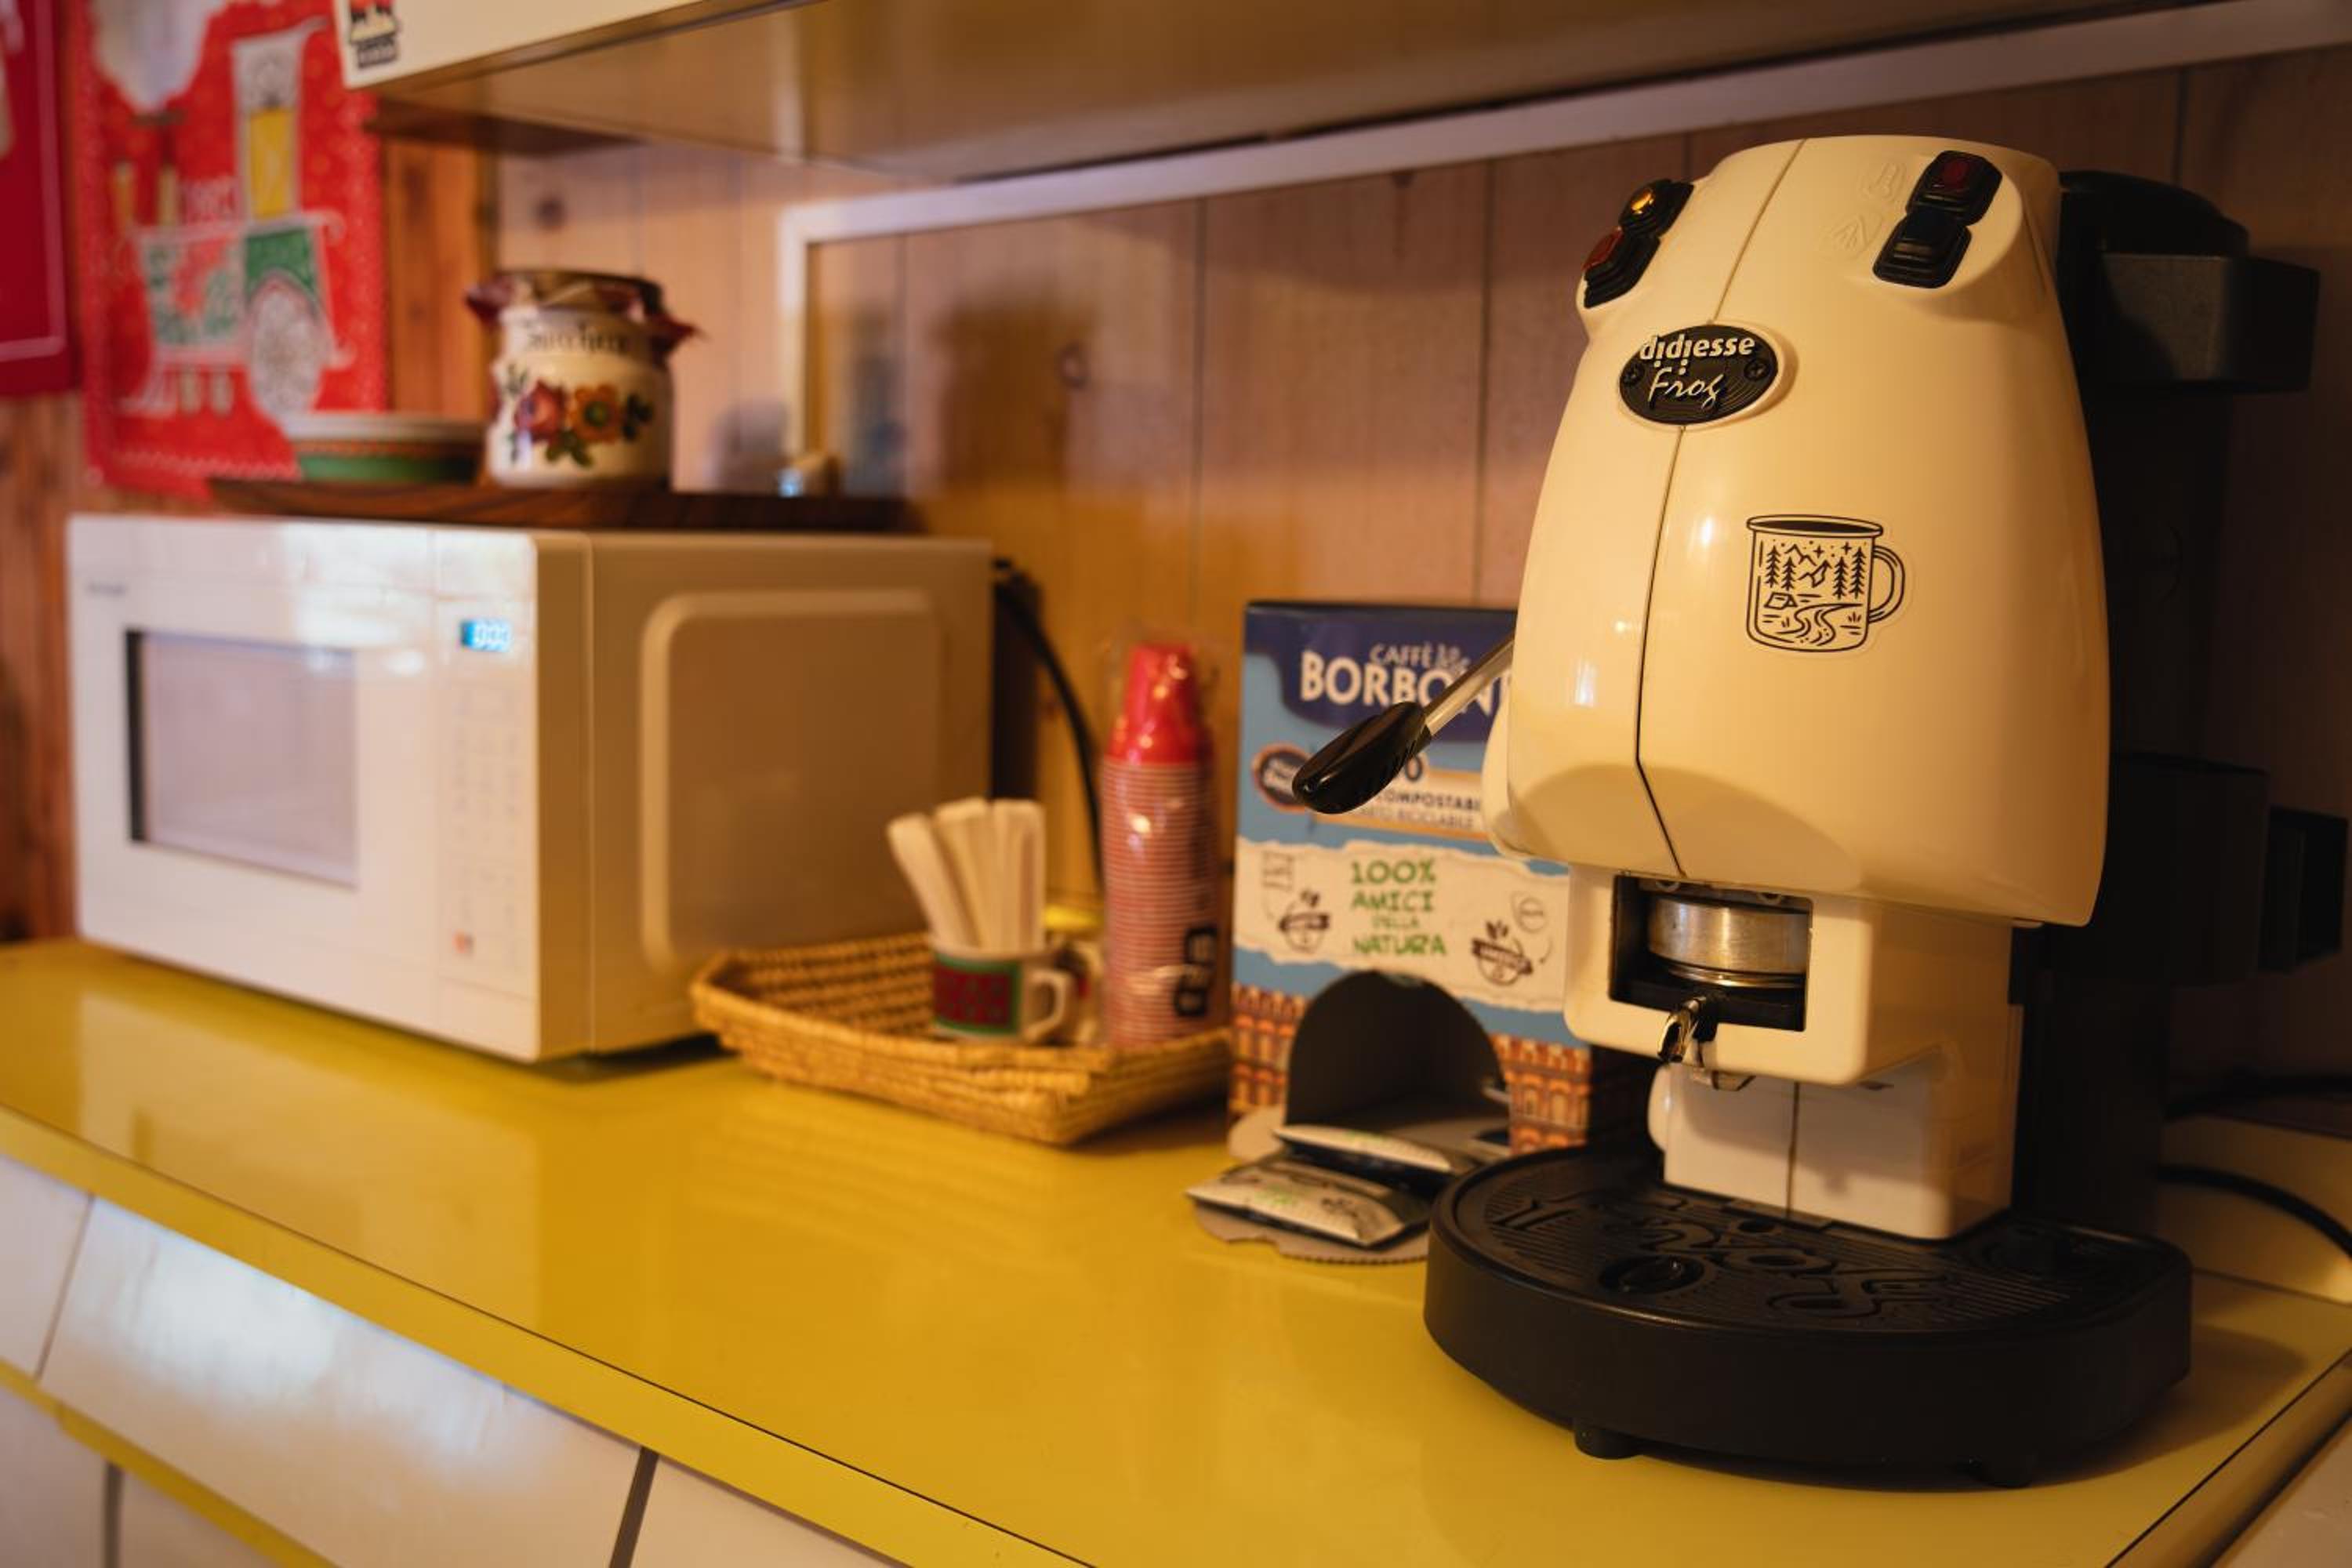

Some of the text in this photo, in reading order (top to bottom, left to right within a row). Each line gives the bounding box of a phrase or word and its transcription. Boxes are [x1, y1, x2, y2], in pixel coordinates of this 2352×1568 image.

[1639, 333, 1755, 368] didiesse
[1647, 366, 1724, 410] Frog
[1352, 858, 1436, 884] 100%
[1351, 891, 1434, 913] AMICI
[1353, 934, 1447, 956] NATURA
